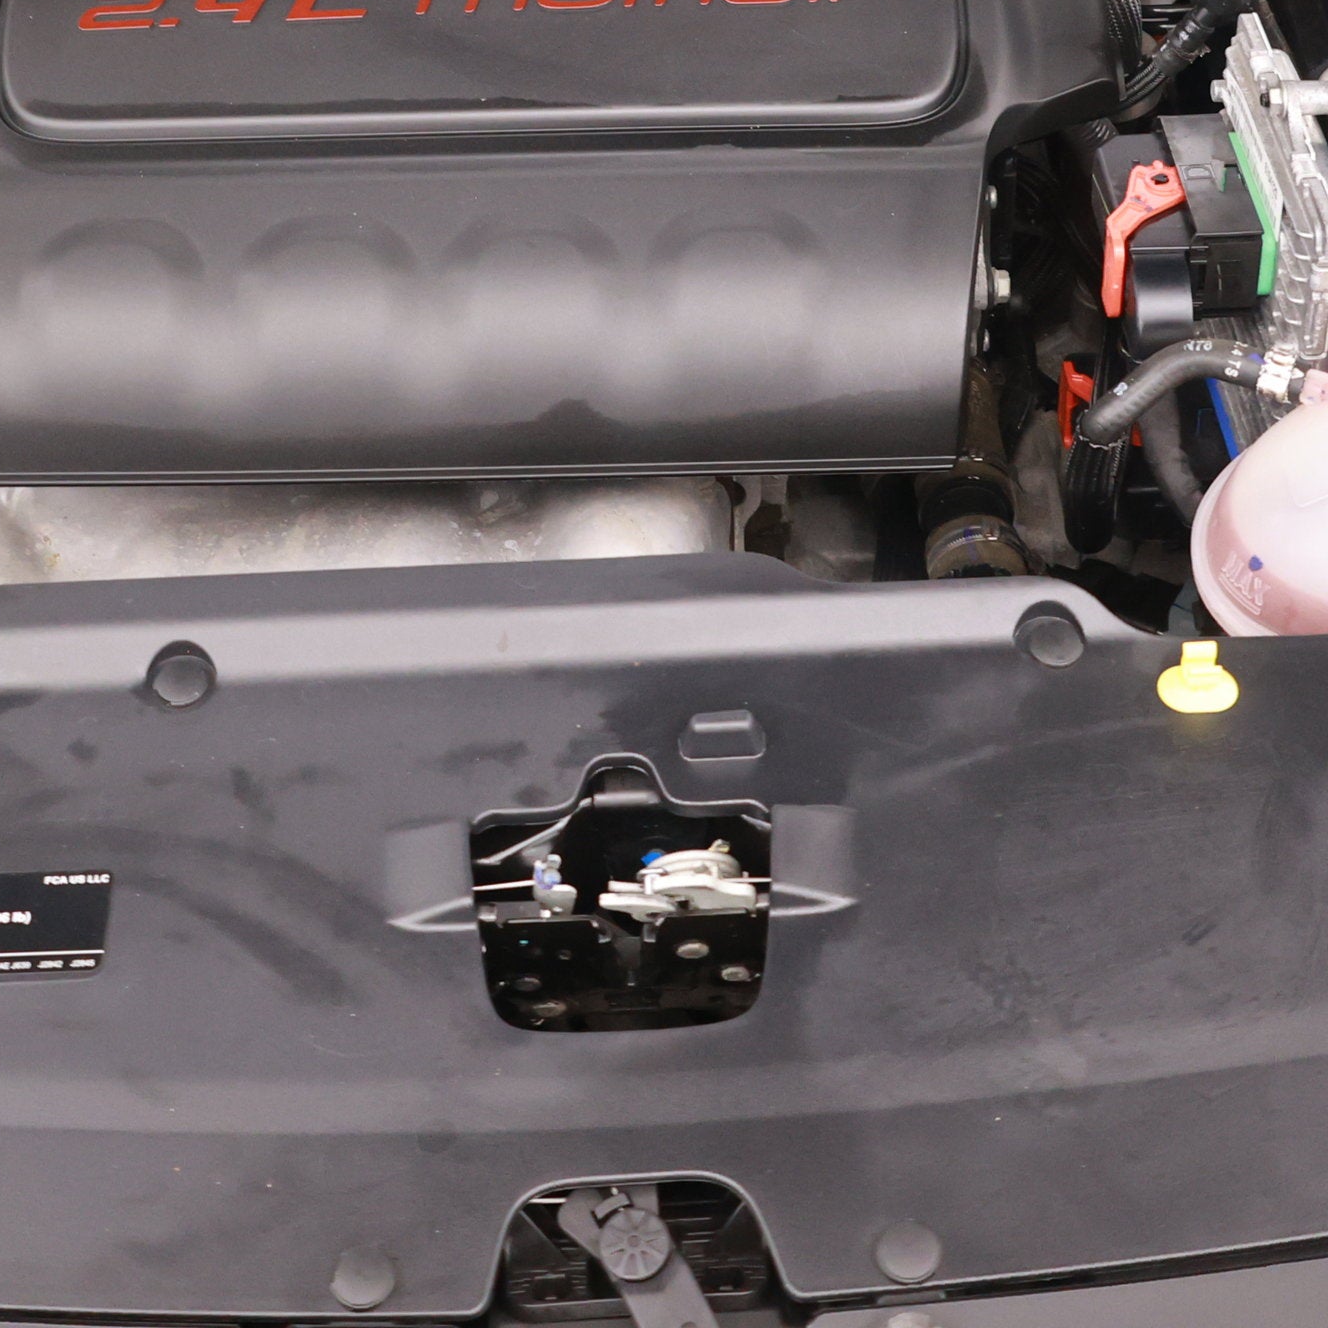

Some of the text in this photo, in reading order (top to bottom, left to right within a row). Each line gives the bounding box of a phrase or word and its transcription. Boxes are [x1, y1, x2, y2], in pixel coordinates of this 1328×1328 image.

[1220, 552, 1271, 606] MAX
[43, 873, 111, 885] FCA US LLC
